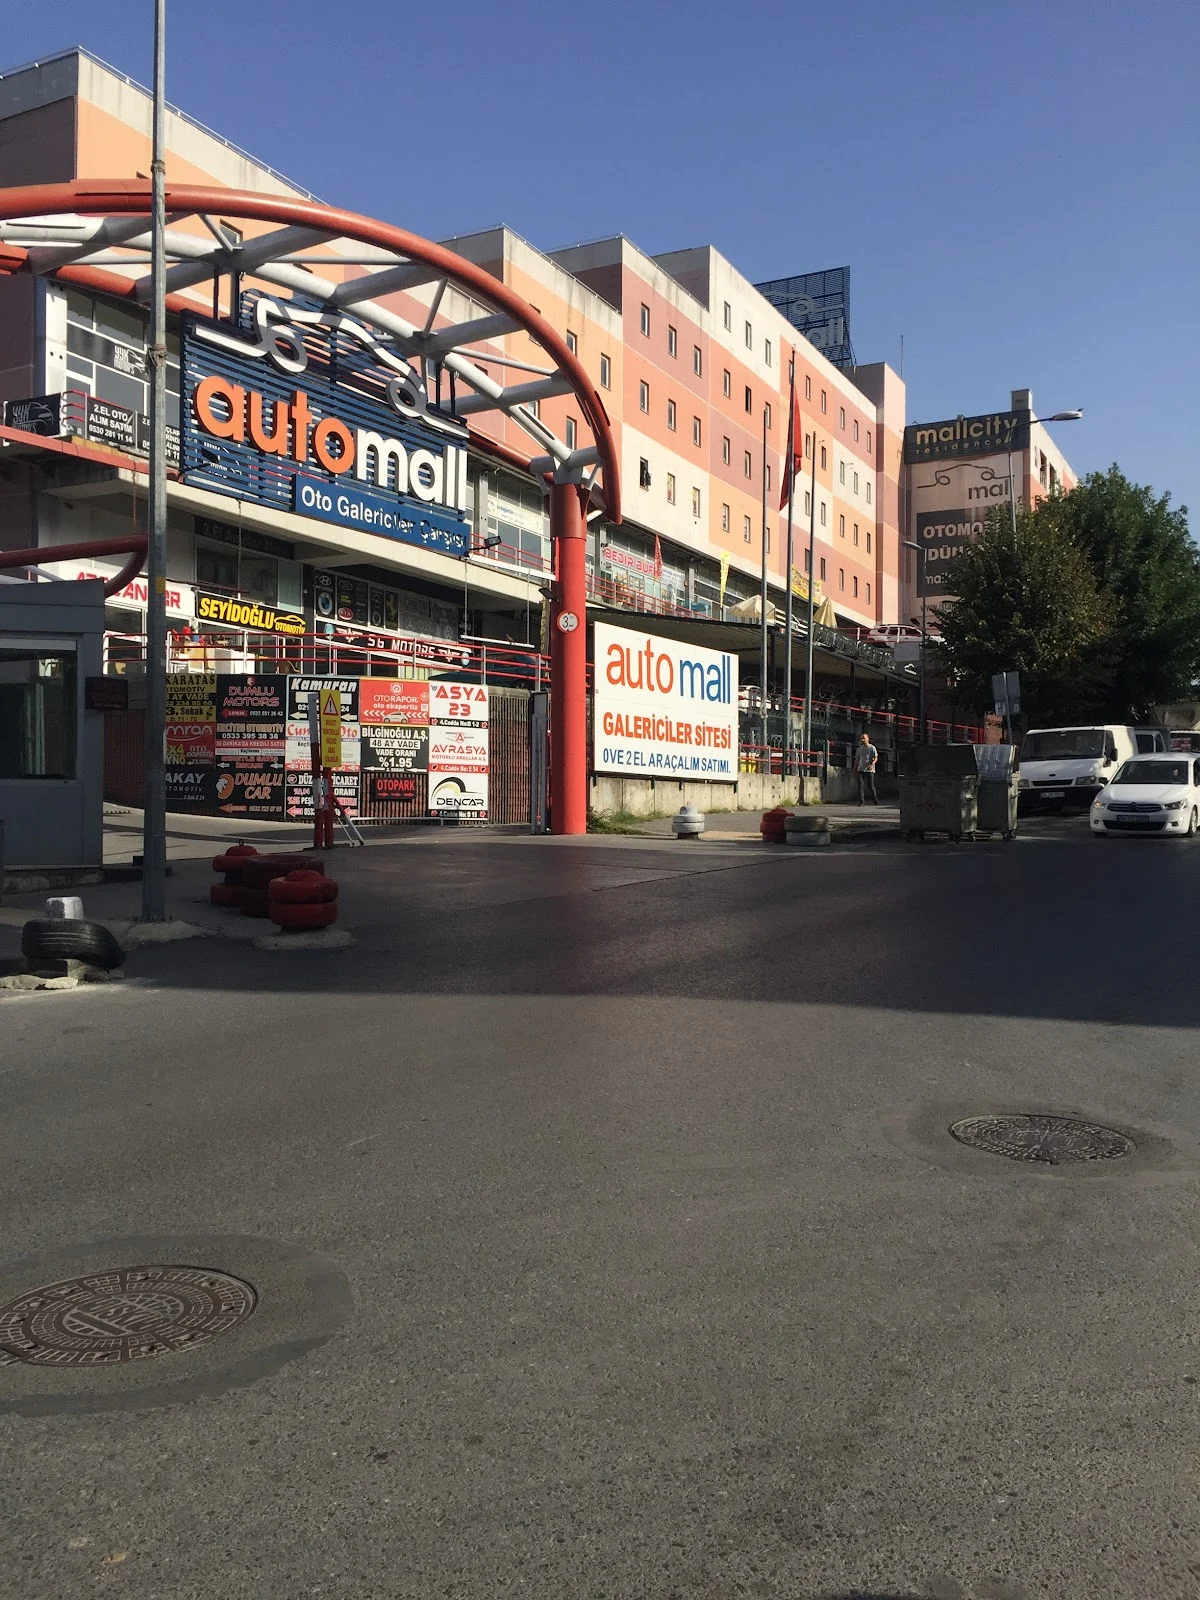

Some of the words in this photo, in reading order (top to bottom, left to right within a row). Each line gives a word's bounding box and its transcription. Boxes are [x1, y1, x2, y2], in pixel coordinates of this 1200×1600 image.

[89, 413, 108, 427] ALIM
[112, 410, 128, 422] OTO
[917, 417, 1018, 445] mallcity
[301, 485, 332, 512] Oto
[199, 597, 275, 630] SEYİDOĞLU
[606, 639, 674, 694] auto
[679, 654, 731, 705] mall
[228, 686, 274, 697] DUMLU
[291, 678, 357, 692] Kamuran
[435, 685, 487, 702] ASYA
[223, 697, 280, 707] MOTORS
[386, 703, 419, 711] ekspertiz
[449, 703, 471, 717] 23
[362, 726, 412, 739] BİLGİNOĞLU
[603, 712, 693, 745] GALERİCİLER
[694, 721, 732, 749] SİTESİ
[397, 740, 418, 748] VADE
[431, 744, 486, 755] AVRASYA
[395, 749, 417, 757] ORANI
[379, 756, 412, 768] %1.95
[234, 772, 283, 786] DUMLU
[377, 780, 415, 791] OTOPARK
[244, 786, 271, 800] CAR
[436, 797, 484, 807] DENCAR
